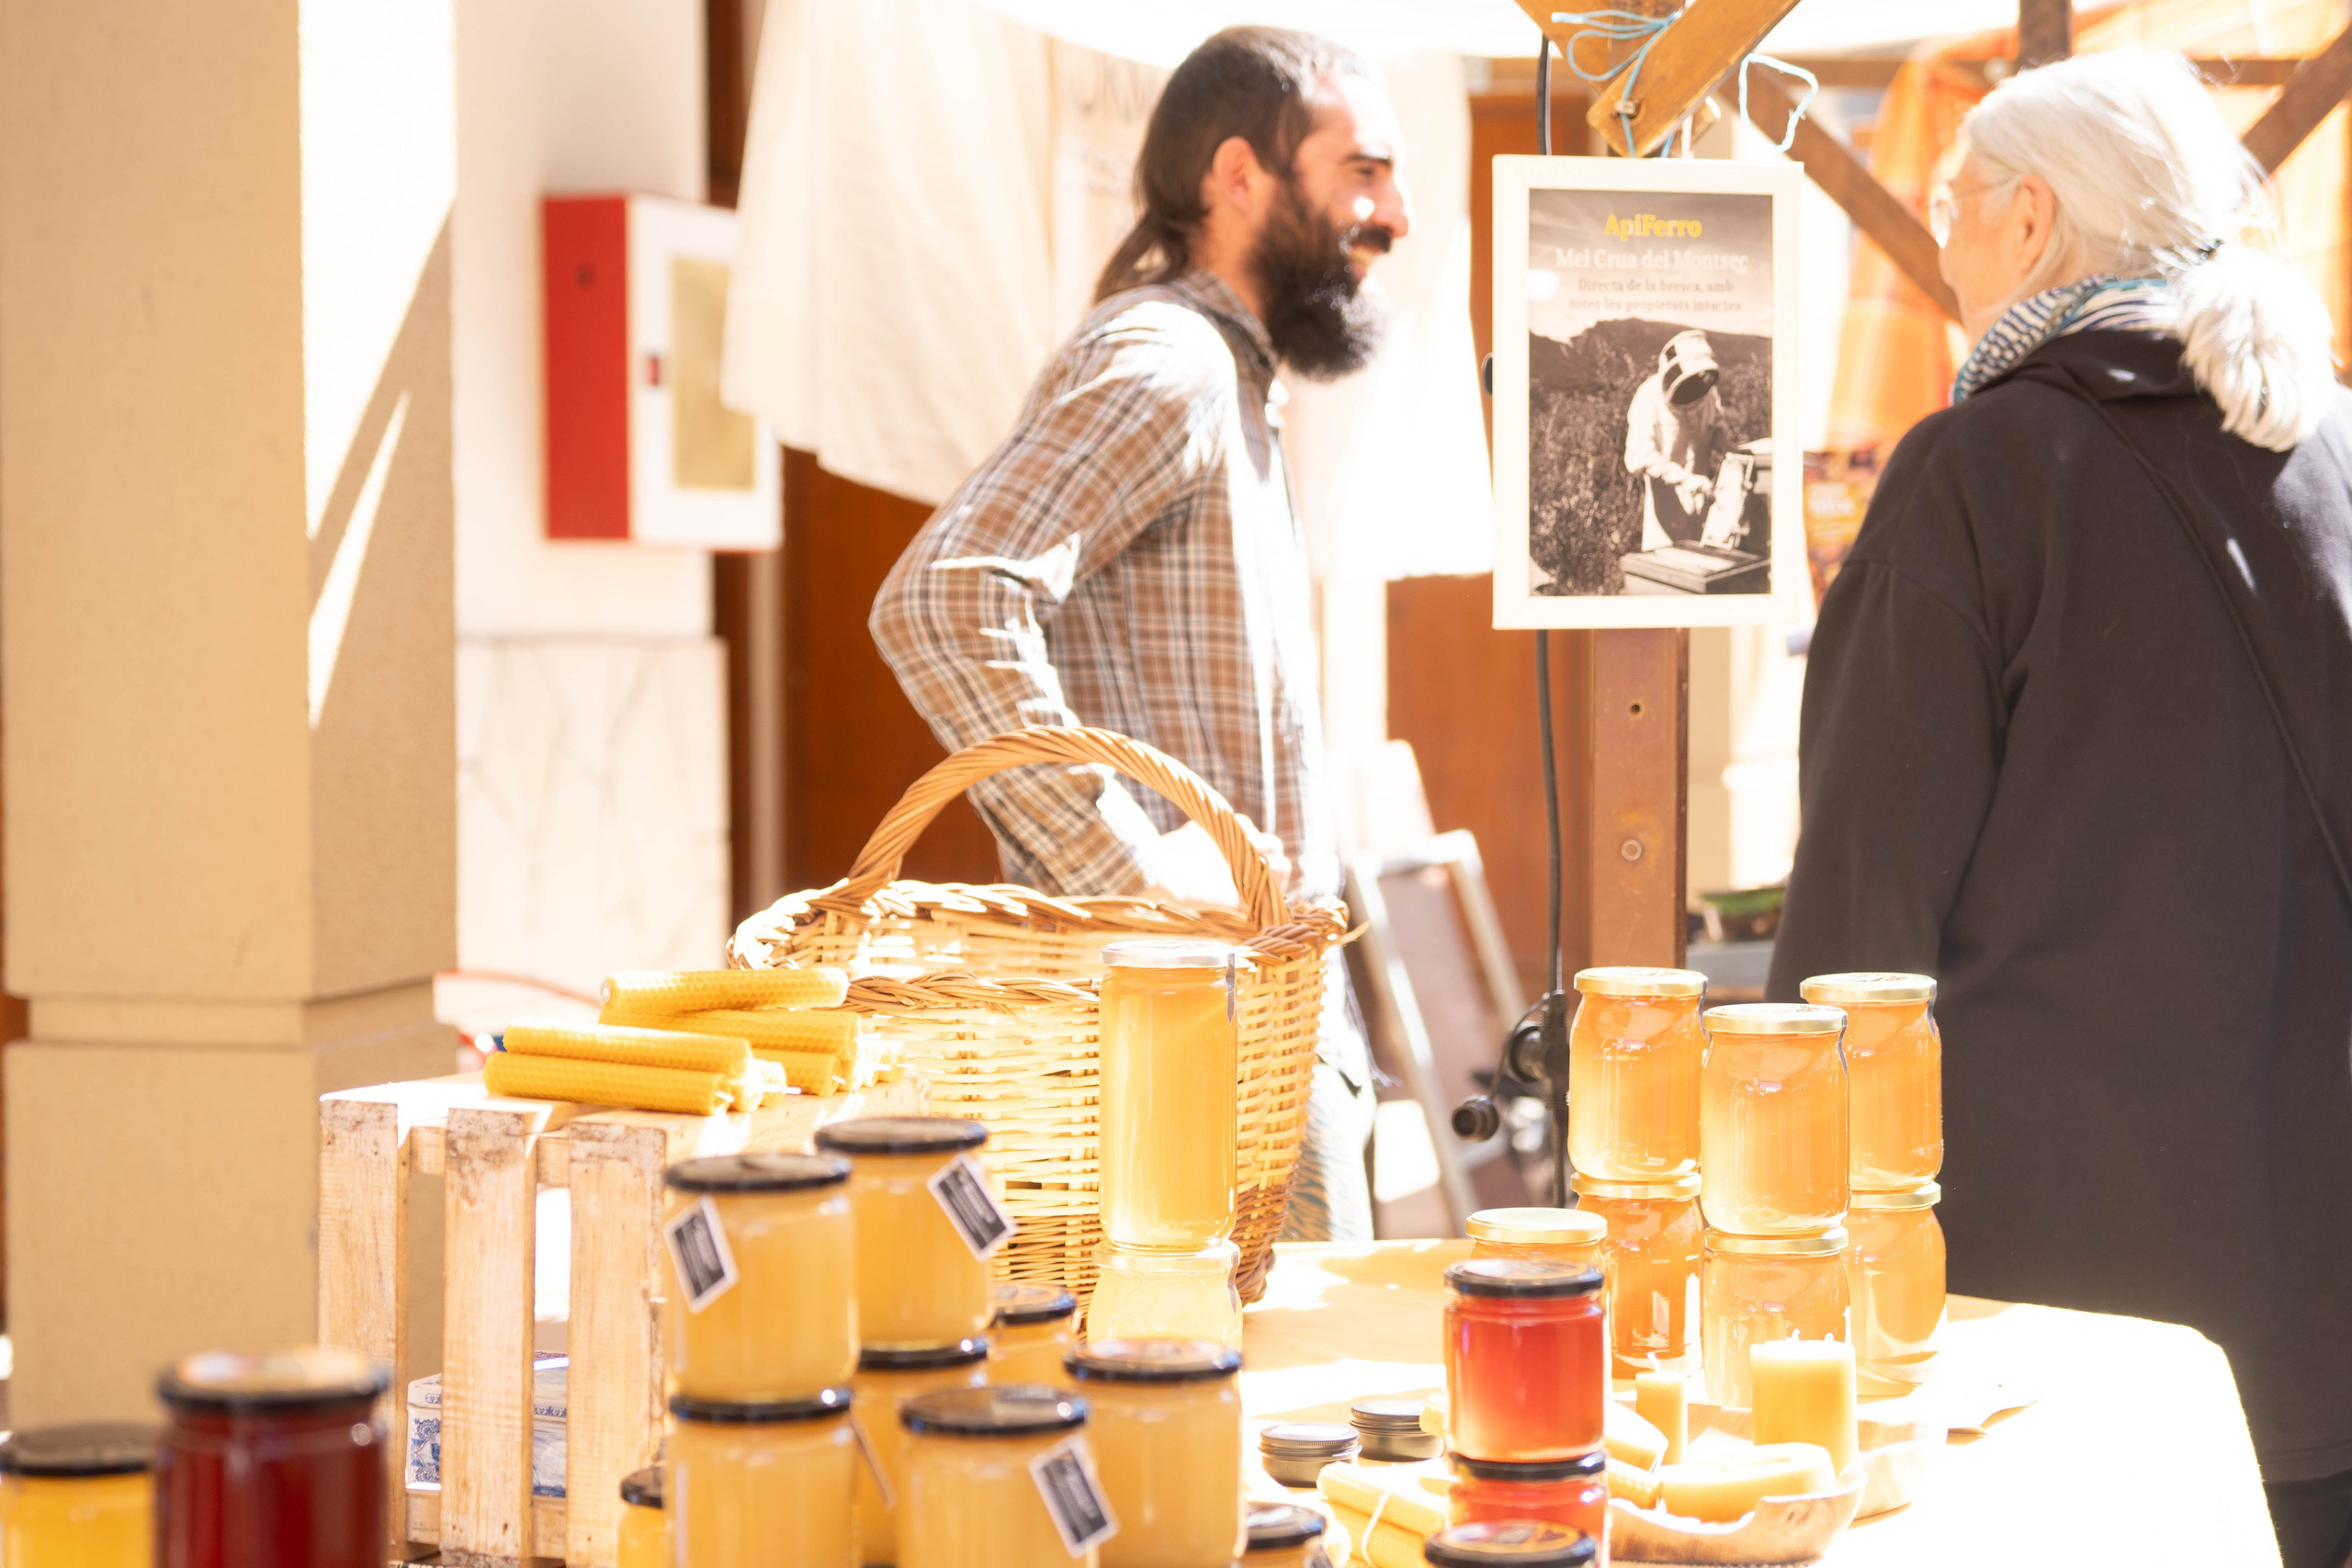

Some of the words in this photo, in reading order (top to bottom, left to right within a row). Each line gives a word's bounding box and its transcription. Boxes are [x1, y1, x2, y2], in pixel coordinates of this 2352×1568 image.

[1603, 213, 1702, 241] ApiFerro
[1555, 248, 1590, 269] Mel
[1594, 248, 1638, 269] Crua
[1641, 249, 1669, 270] del
[1672, 250, 1749, 272] Montsec
[1577, 277, 1624, 293] Directa
[1626, 277, 1642, 292] de
[1645, 278, 1657, 293] la
[1705, 279, 1735, 293] amb
[1569, 299, 1600, 310] totes
[1604, 299, 1621, 310] les
